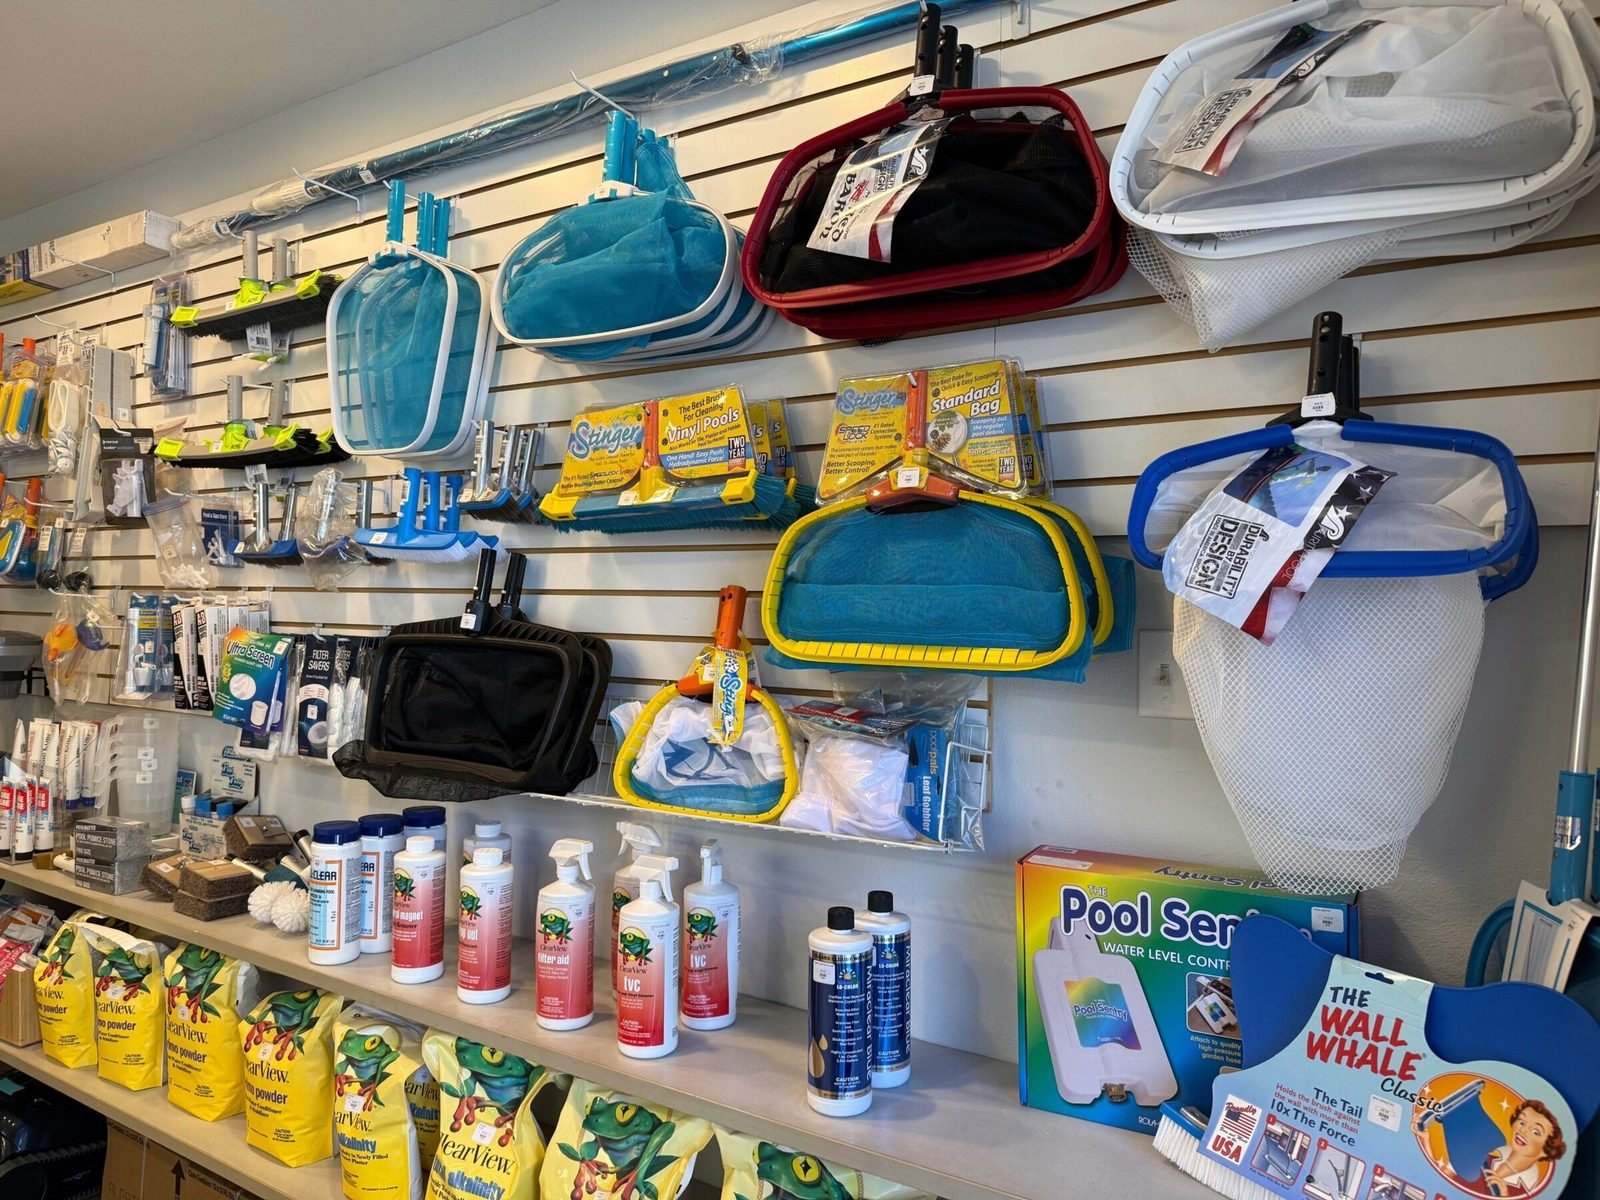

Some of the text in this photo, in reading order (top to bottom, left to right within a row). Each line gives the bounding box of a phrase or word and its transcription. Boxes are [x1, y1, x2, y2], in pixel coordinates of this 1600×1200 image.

[1182, 92, 1234, 149] DESIGN
[679, 390, 725, 415] The Best Brush
[839, 387, 897, 415] Stinger
[931, 379, 1000, 414] Standard
[683, 402, 724, 422] For Cleaning
[970, 398, 1000, 417] Bag
[667, 418, 700, 443] Vinyl
[703, 407, 739, 432] Pools
[571, 421, 640, 459] Stinger
[728, 436, 745, 449] TWO
[666, 448, 725, 462] One Hand! Easy Push!
[668, 457, 707, 468] Hydrodynamic
[728, 448, 745, 459] YEAR
[1000, 456, 1014, 466] TWO
[827, 460, 846, 468] Better
[1000, 465, 1014, 474] YEAR
[1194, 518, 1240, 589] DESIGN
[1222, 525, 1261, 596] DURABILITY
[1225, 550, 1236, 563] BY
[227, 641, 247, 656] Ultra
[246, 645, 275, 669] Screen
[312, 649, 329, 660] FILTER
[308, 660, 330, 671] SAVERS
[923, 775, 932, 832] Leaf Gobbler
[76, 832, 117, 846] POOL PUMICE STONE
[76, 865, 115, 880] POOL PUMICE STONE
[1088, 884, 1107, 897] THE
[1060, 885, 1152, 937] Pool
[1160, 897, 1252, 949] Sen
[557, 954, 570, 965] aid
[1104, 942, 1184, 964] WATER LEVEL
[1330, 986, 1371, 1008] THE
[1073, 1003, 1128, 1022] Pool Sentry
[107, 1020, 136, 1031] powder
[1321, 1004, 1408, 1047] WALL
[1190, 1035, 1211, 1045] Attach
[1220, 1041, 1241, 1050] quality
[1198, 1044, 1241, 1057] high-pressure
[180, 1046, 207, 1063] powder
[1202, 1052, 1241, 1065] garden hose
[1306, 1031, 1422, 1081] WHALE
[256, 1087, 288, 1105] powder
[1276, 1083, 1296, 1098] Holds
[1298, 1093, 1310, 1102] the
[1311, 1096, 1332, 1112] brush
[1333, 1107, 1361, 1126] against
[1314, 1087, 1338, 1107] The
[1340, 1098, 1363, 1119] Tail
[1381, 1077, 1442, 1113] Classic
[1225, 1101, 1257, 1116] Proudly
[1274, 1091, 1360, 1135] the wall with more than
[1270, 1098, 1357, 1147] 10x The Force
[1211, 1135, 1243, 1164] USA
